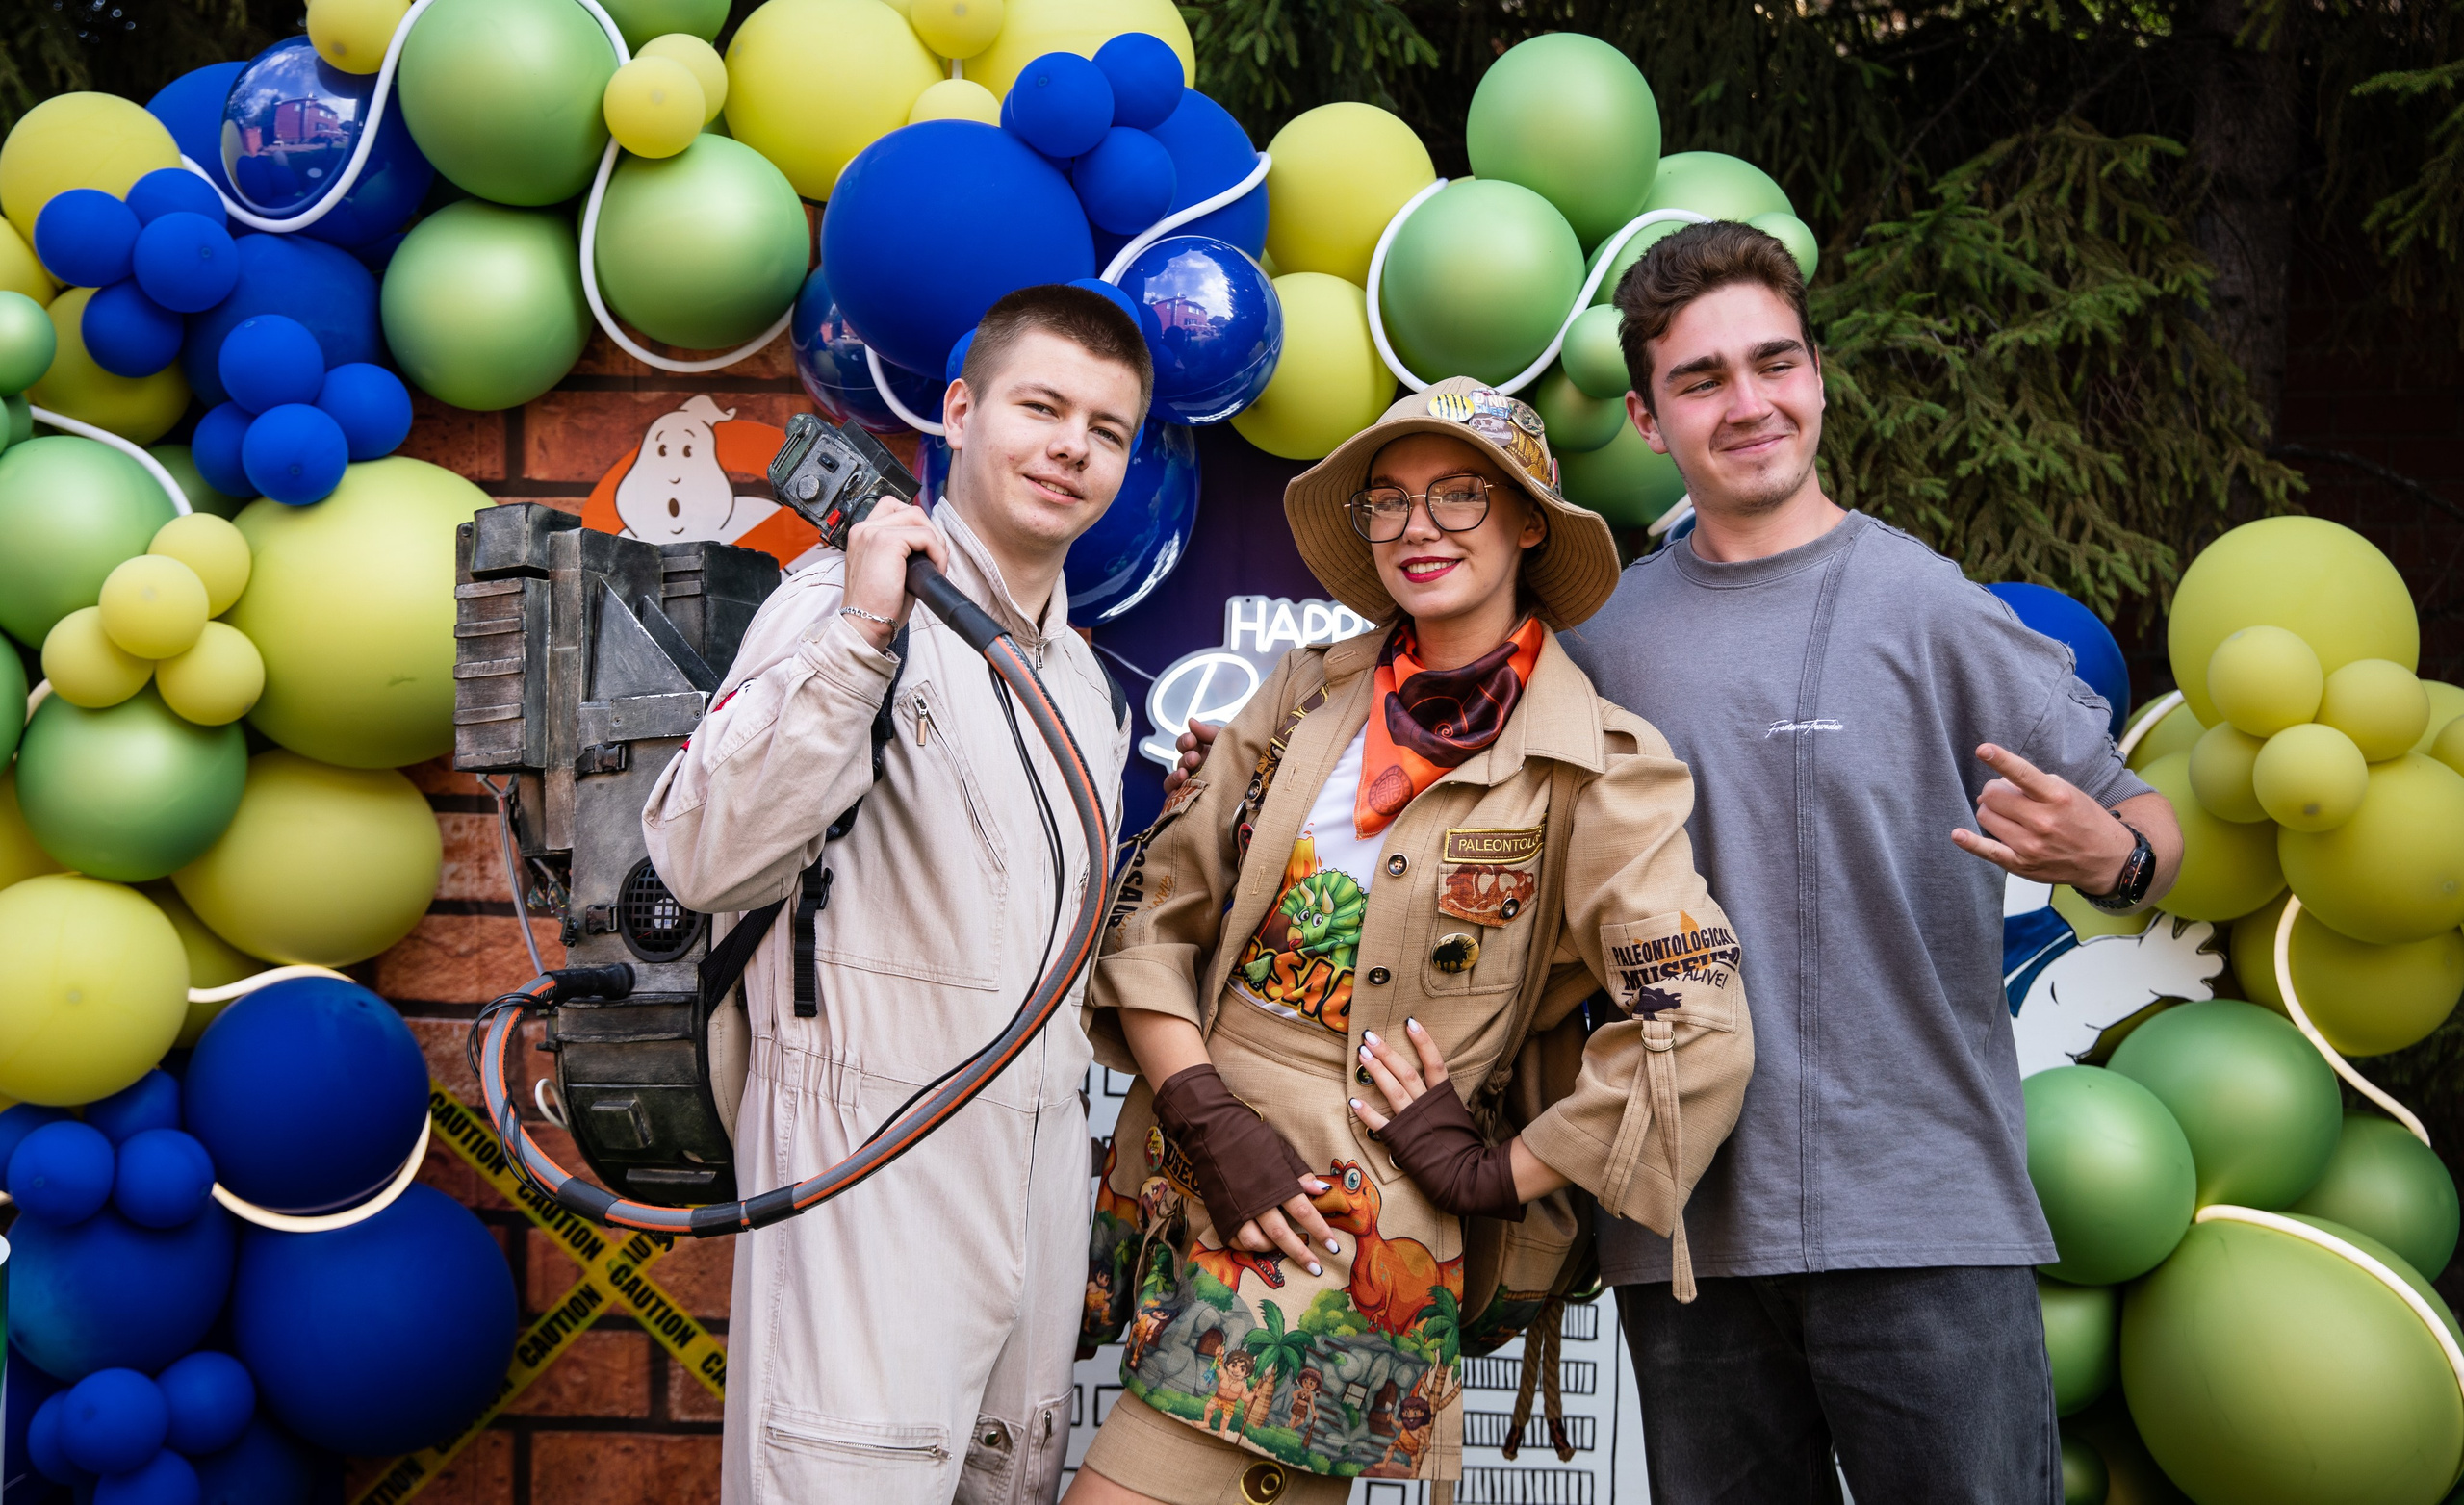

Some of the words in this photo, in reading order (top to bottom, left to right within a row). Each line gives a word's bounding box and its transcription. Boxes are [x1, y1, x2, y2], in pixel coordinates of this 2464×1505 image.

[1230, 600, 1376, 653] HAPP
[1457, 835, 1540, 852] PALEONTOLO
[1612, 927, 1735, 966] PALEONTOLOGICAL
[1682, 968, 1729, 989] ALIVE!
[430, 1091, 507, 1177] CAUTION
[608, 1263, 697, 1349] CAUTION
[516, 1284, 603, 1368] CAUTION
